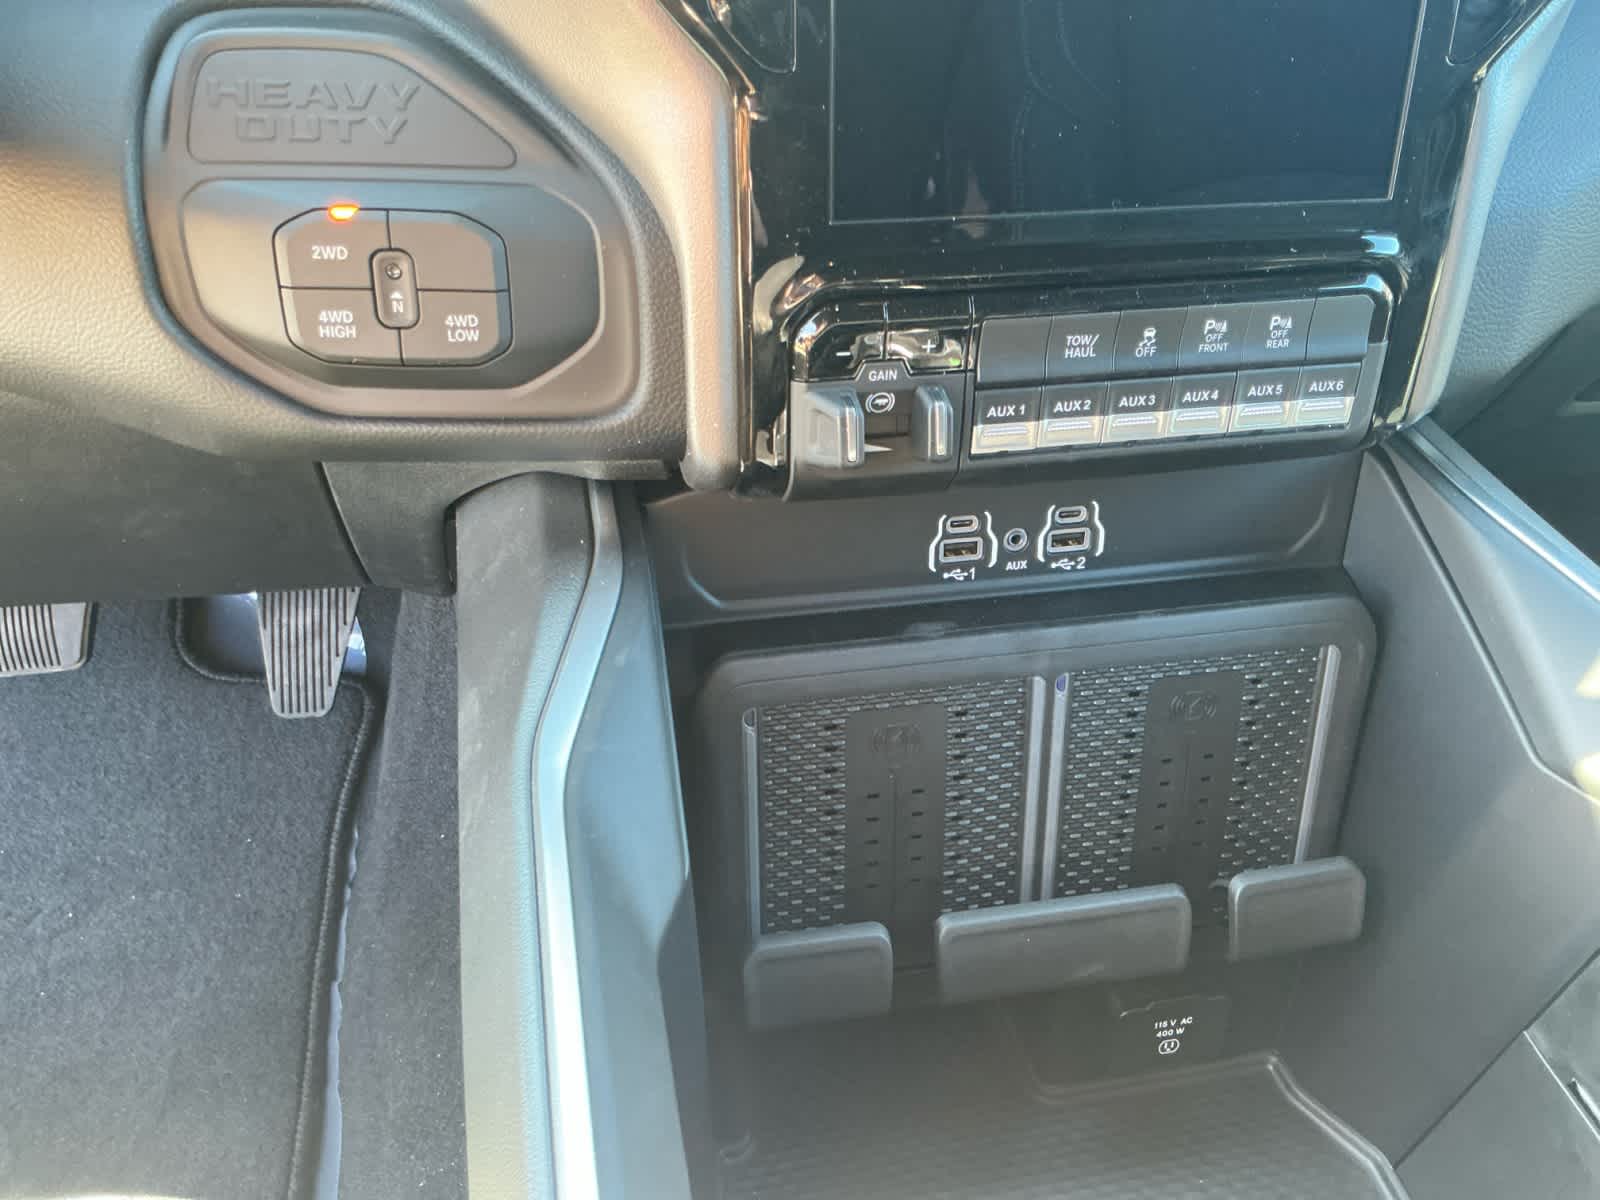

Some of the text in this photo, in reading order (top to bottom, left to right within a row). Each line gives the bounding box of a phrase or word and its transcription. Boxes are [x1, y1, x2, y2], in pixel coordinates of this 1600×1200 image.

[207, 79, 421, 111] HEAVY
[311, 245, 349, 261] 2WD
[391, 300, 404, 313] N
[319, 310, 353, 325] 4WD
[445, 314, 479, 328] 4WD
[319, 325, 357, 339] HIGH
[447, 329, 480, 343] LOW
[1205, 333, 1223, 344] OFF
[1270, 329, 1289, 339] OFF
[1065, 333, 1100, 347] TOW/
[1266, 339, 1290, 350] REAR
[1064, 346, 1097, 360] HAUL
[1135, 346, 1157, 358] OFF
[1199, 343, 1228, 353] FRONT
[868, 369, 898, 382] GAIN
[987, 404, 1026, 418] AUX 1
[1054, 399, 1092, 413] AUX 2
[1005, 559, 1028, 571] AUX
[1077, 557, 1086, 569] 2
[970, 567, 977, 581] 1
[1156, 1027, 1185, 1038] 400 W
